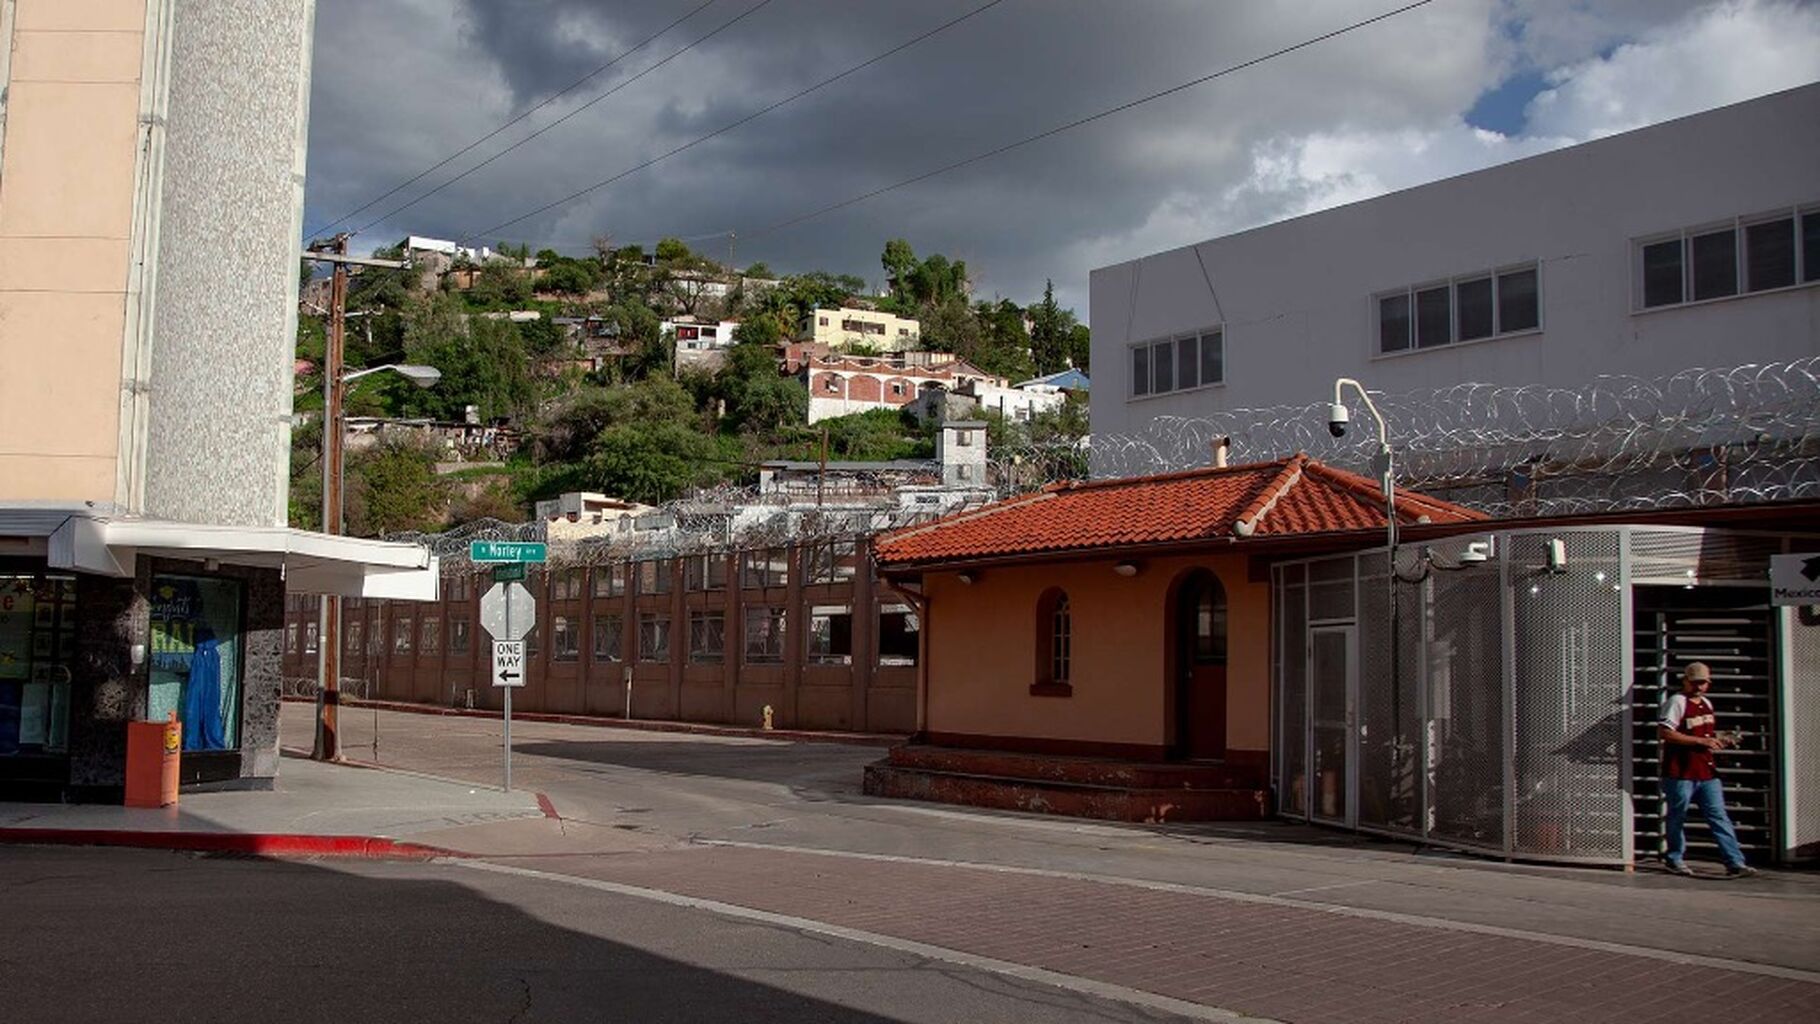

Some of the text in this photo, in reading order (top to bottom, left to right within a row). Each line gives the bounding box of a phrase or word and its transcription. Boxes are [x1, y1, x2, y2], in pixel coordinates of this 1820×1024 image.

[489, 543, 522, 560] Morley
[497, 643, 521, 655] ONE
[497, 656, 521, 668] WAY
